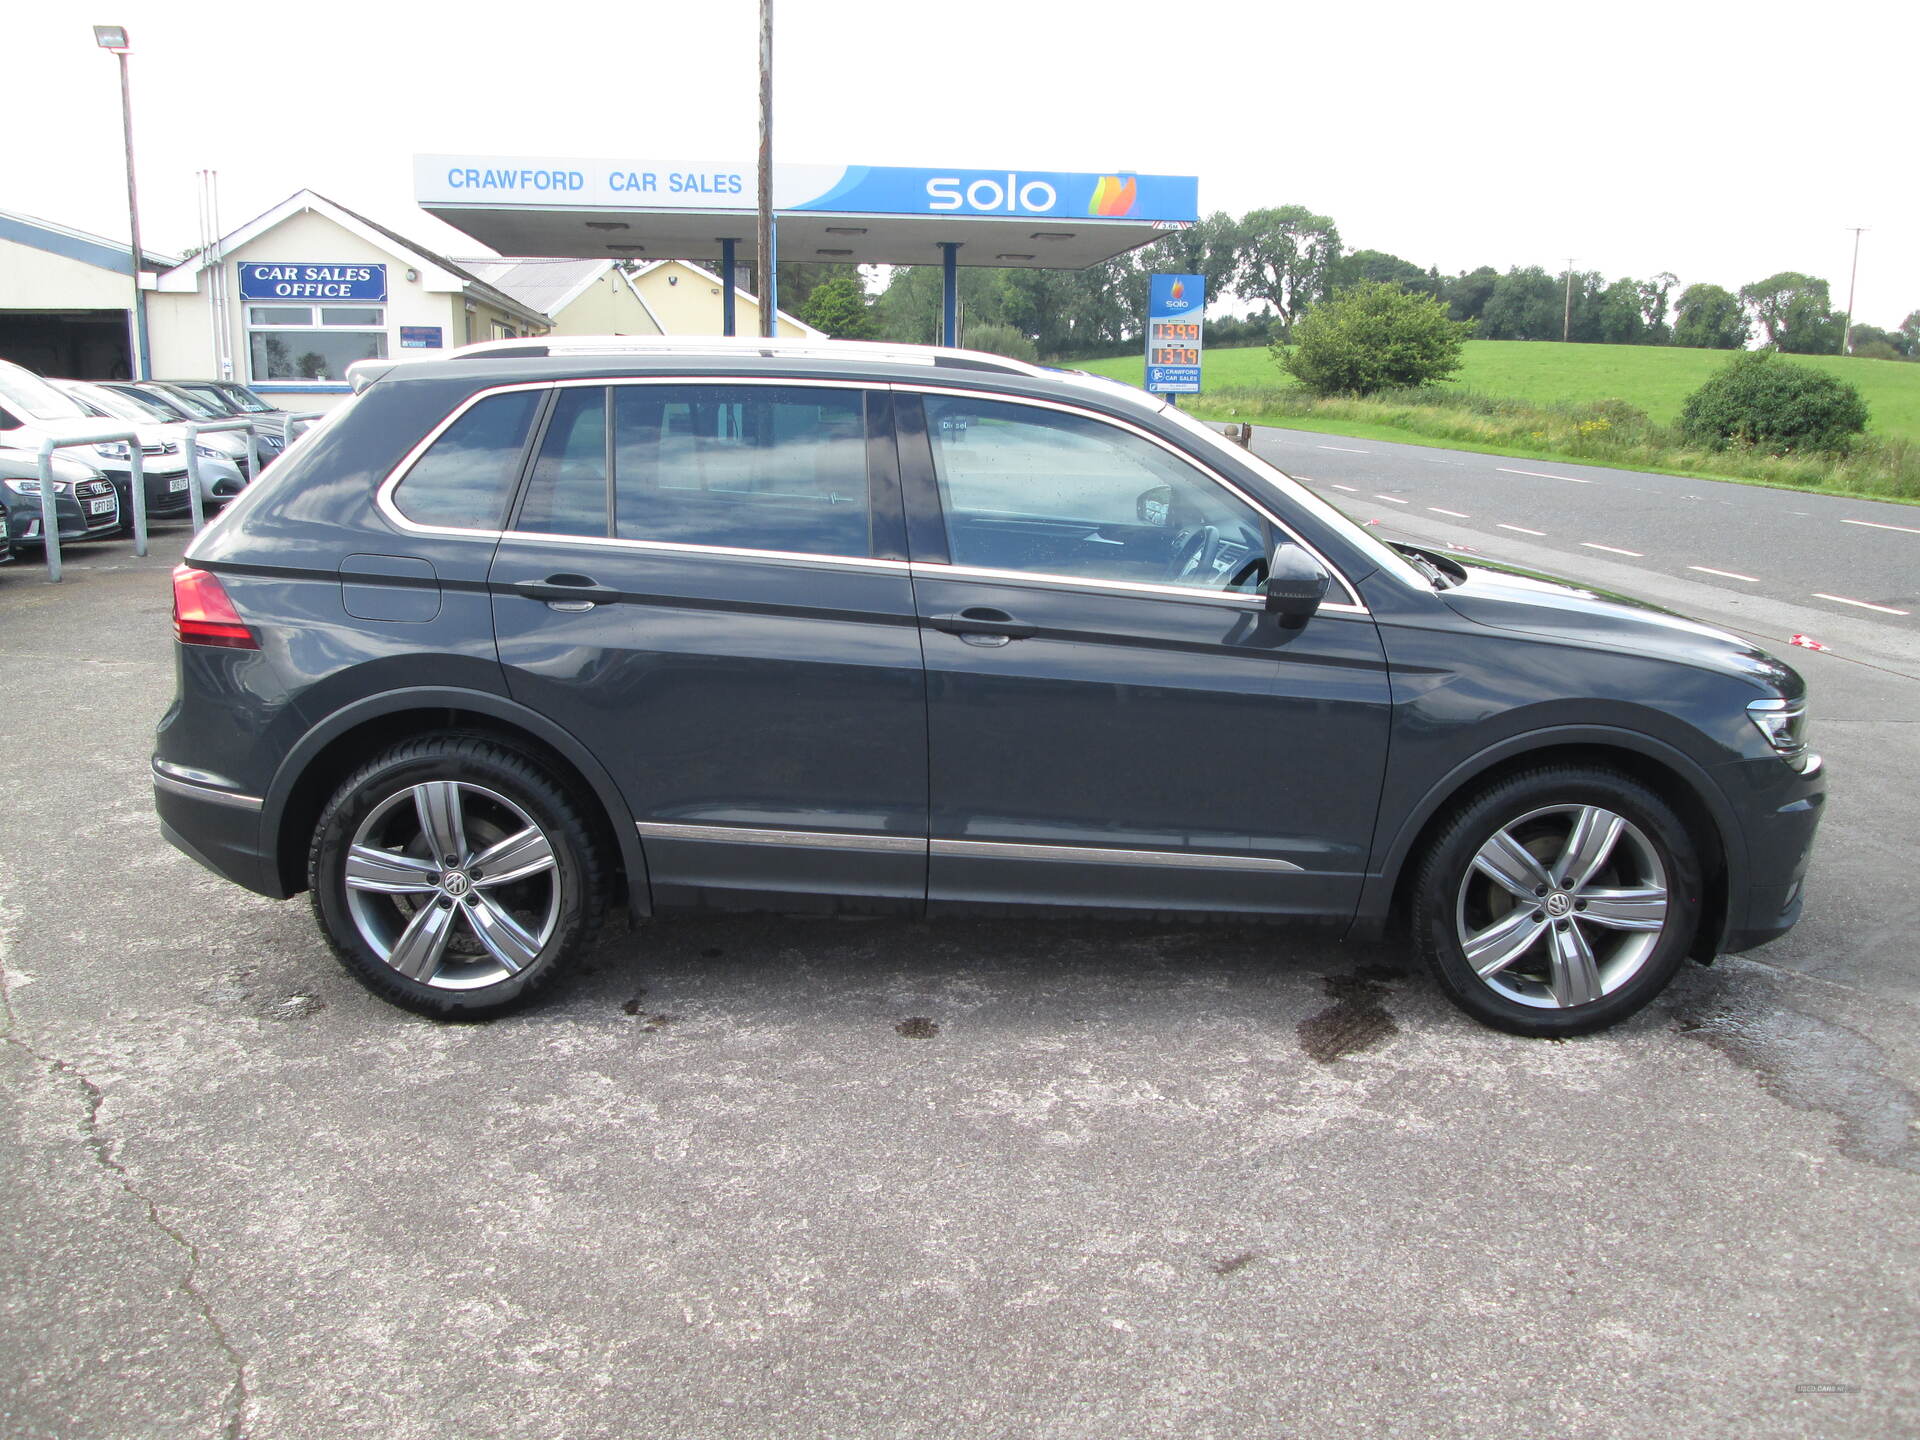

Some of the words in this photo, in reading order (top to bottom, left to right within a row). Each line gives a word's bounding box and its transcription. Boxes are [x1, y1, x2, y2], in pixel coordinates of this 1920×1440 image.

[448, 168, 584, 191] CRAWFORD
[609, 172, 657, 191] CAR
[669, 173, 742, 193] SALES
[926, 174, 1057, 211] solo
[254, 267, 298, 280] CAR
[304, 267, 371, 281] SALES
[275, 283, 352, 297] OFFICE
[1166, 299, 1189, 308] solo
[1158, 324, 1198, 340] 139.9
[1158, 349, 1197, 364] 137.9
